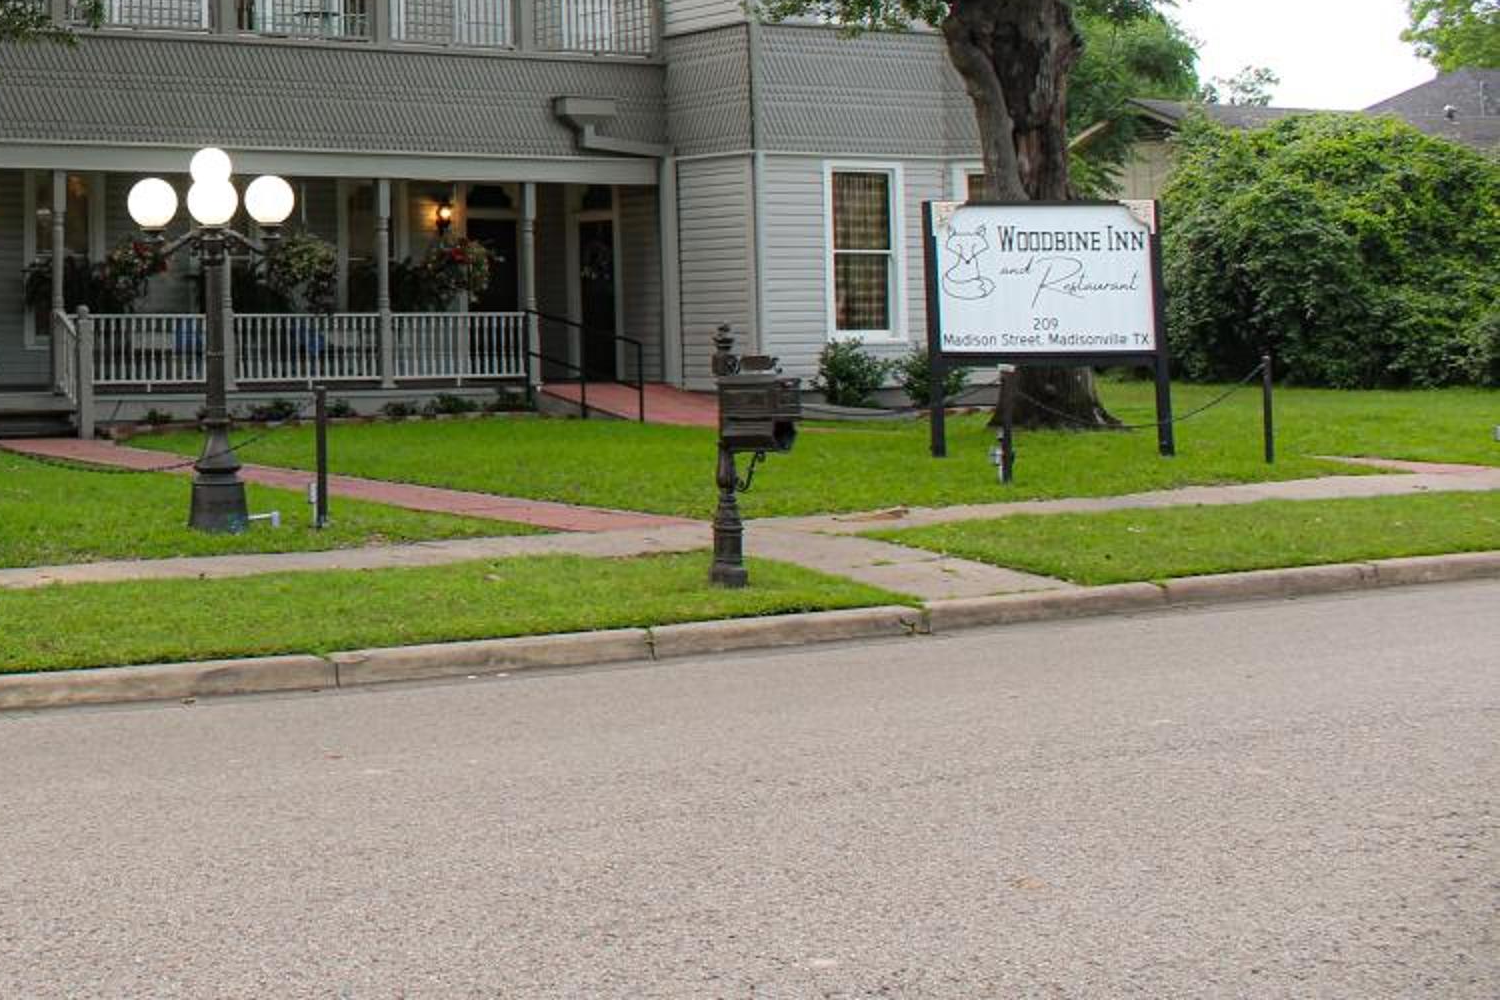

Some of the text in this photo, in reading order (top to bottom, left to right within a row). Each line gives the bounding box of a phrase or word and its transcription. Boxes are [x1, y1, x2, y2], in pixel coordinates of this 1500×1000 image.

[997, 225, 1145, 252] WOODBINE INN
[1000, 256, 1139, 308] and Restaurant
[1033, 317, 1059, 331] 209
[943, 333, 997, 346] Madison
[1048, 333, 1127, 346] Madisonville
[1132, 333, 1150, 345] TX
